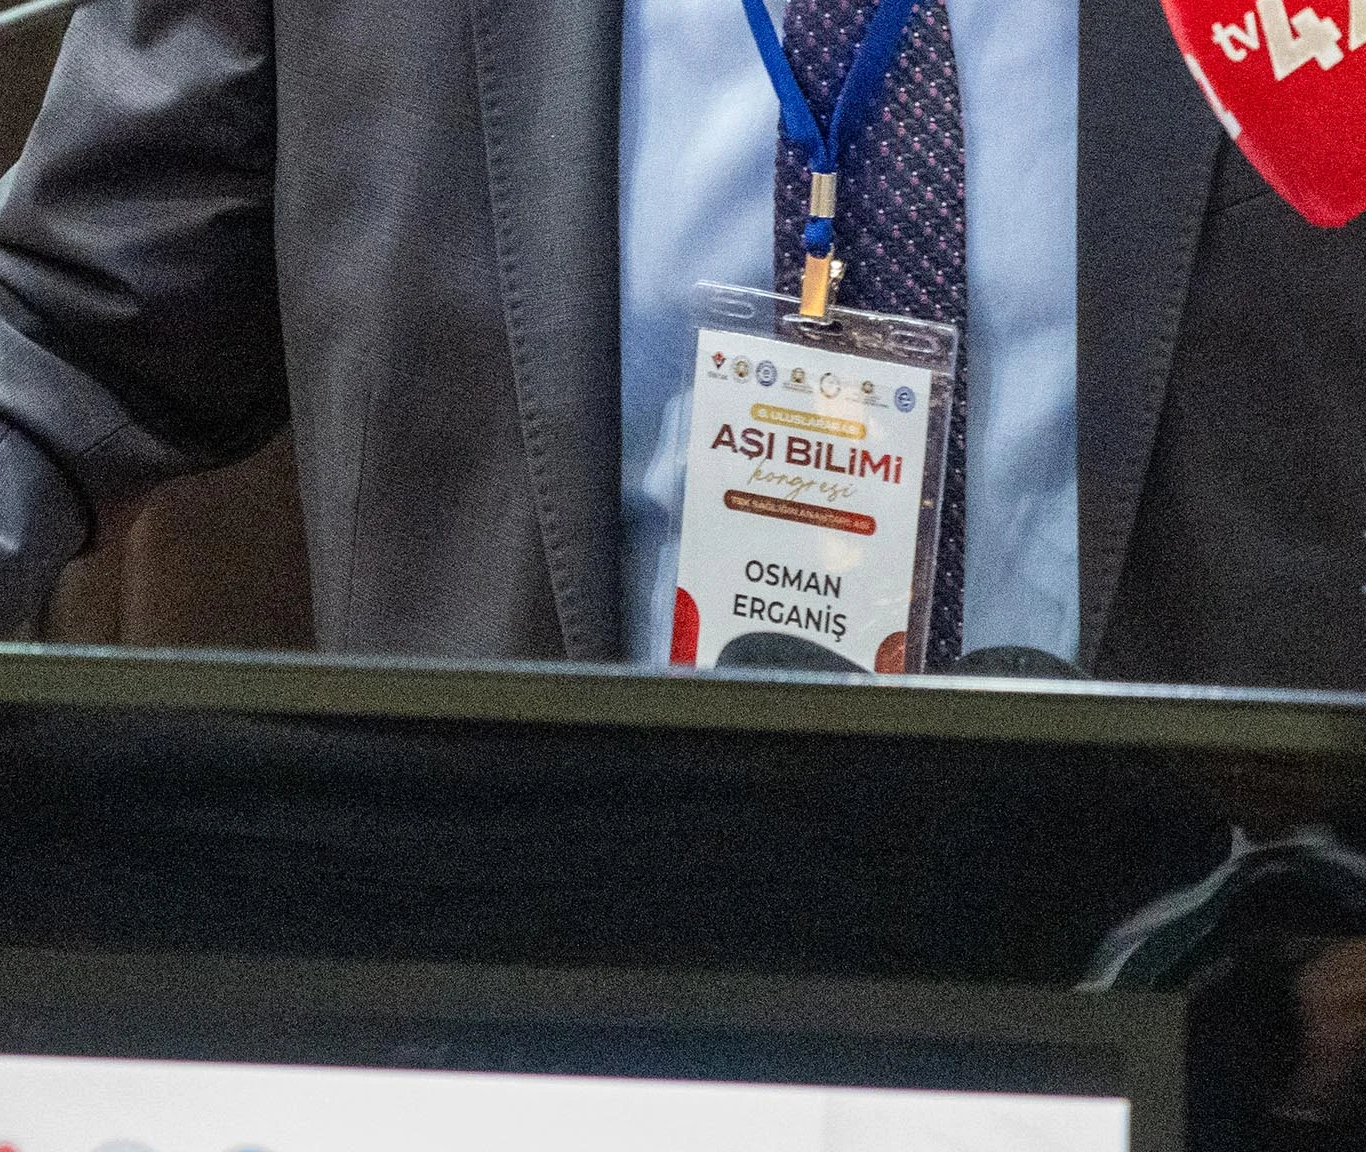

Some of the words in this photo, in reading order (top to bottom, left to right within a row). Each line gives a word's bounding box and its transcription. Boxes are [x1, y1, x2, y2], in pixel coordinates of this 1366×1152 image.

[711, 423, 775, 460] AŞI
[745, 560, 841, 598] OSMAN
[733, 594, 847, 642] ERGANİŞ
